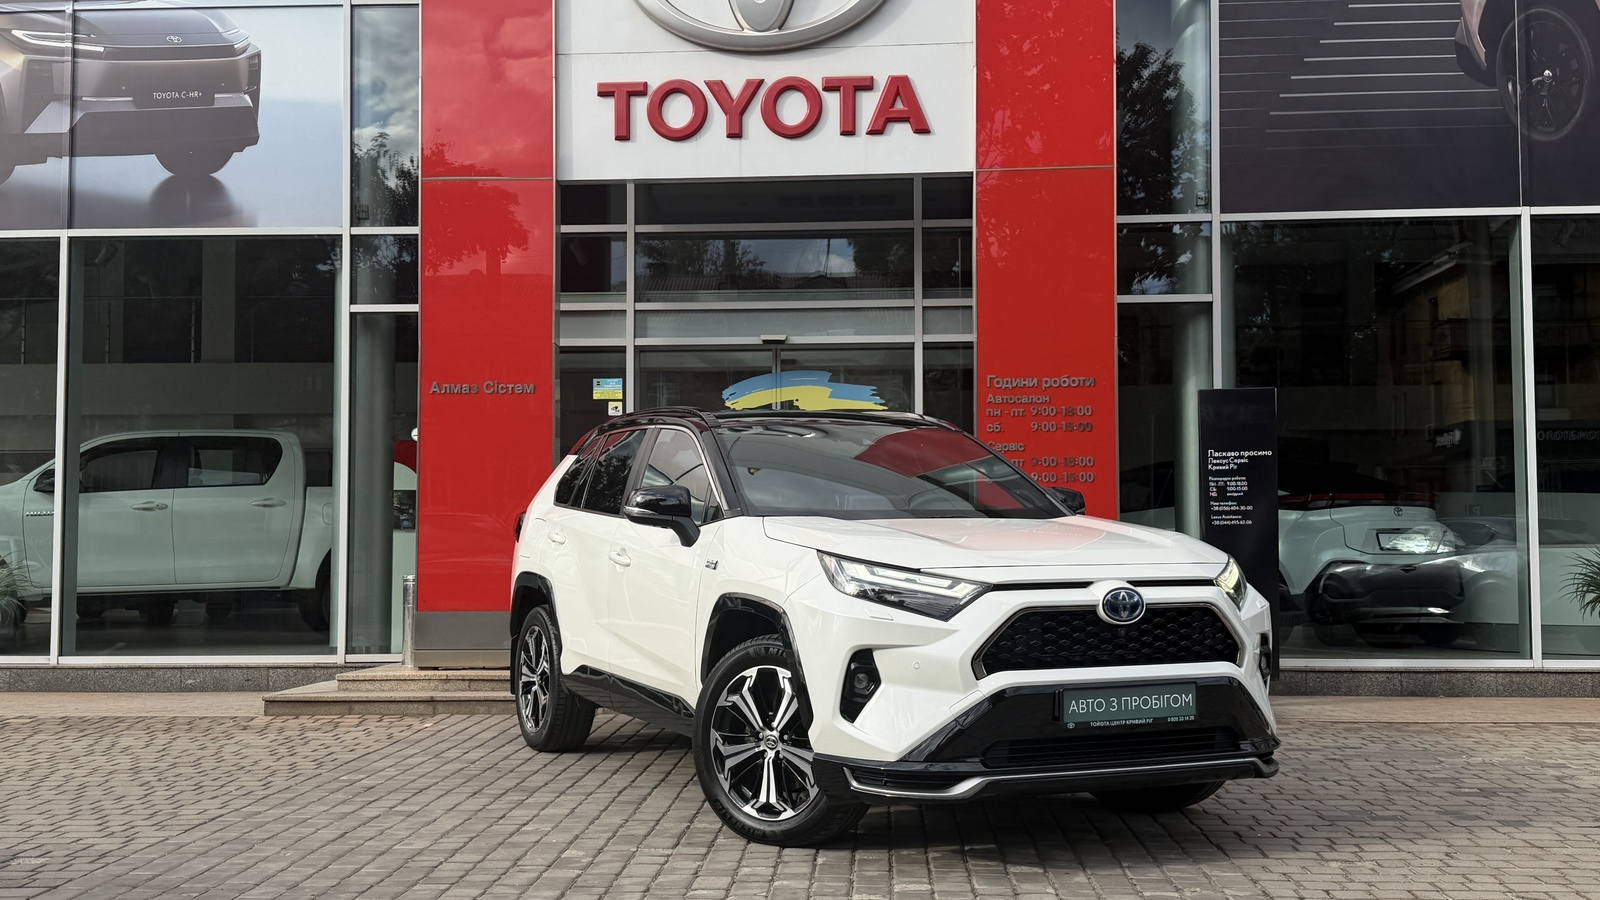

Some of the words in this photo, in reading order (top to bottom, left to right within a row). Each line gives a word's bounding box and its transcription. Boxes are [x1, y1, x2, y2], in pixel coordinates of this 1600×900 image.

[181, 91, 202, 99] C-HR+
[597, 74, 932, 142] TOYOTA
[429, 381, 478, 394] Алмаз
[483, 380, 535, 394] Сістем
[986, 375, 1038, 390] Години
[1042, 374, 1095, 391] роботи
[986, 393, 1050, 404] Автосалон
[986, 408, 1001, 416] пн
[986, 421, 1004, 432] сб.
[987, 441, 1025, 453] Сервіс
[1240, 450, 1273, 458] просимо
[1229, 456, 1249, 464] Сервіс
[1068, 698, 1106, 714] АВТО
[1121, 693, 1193, 711] ПРОБІГОМ
